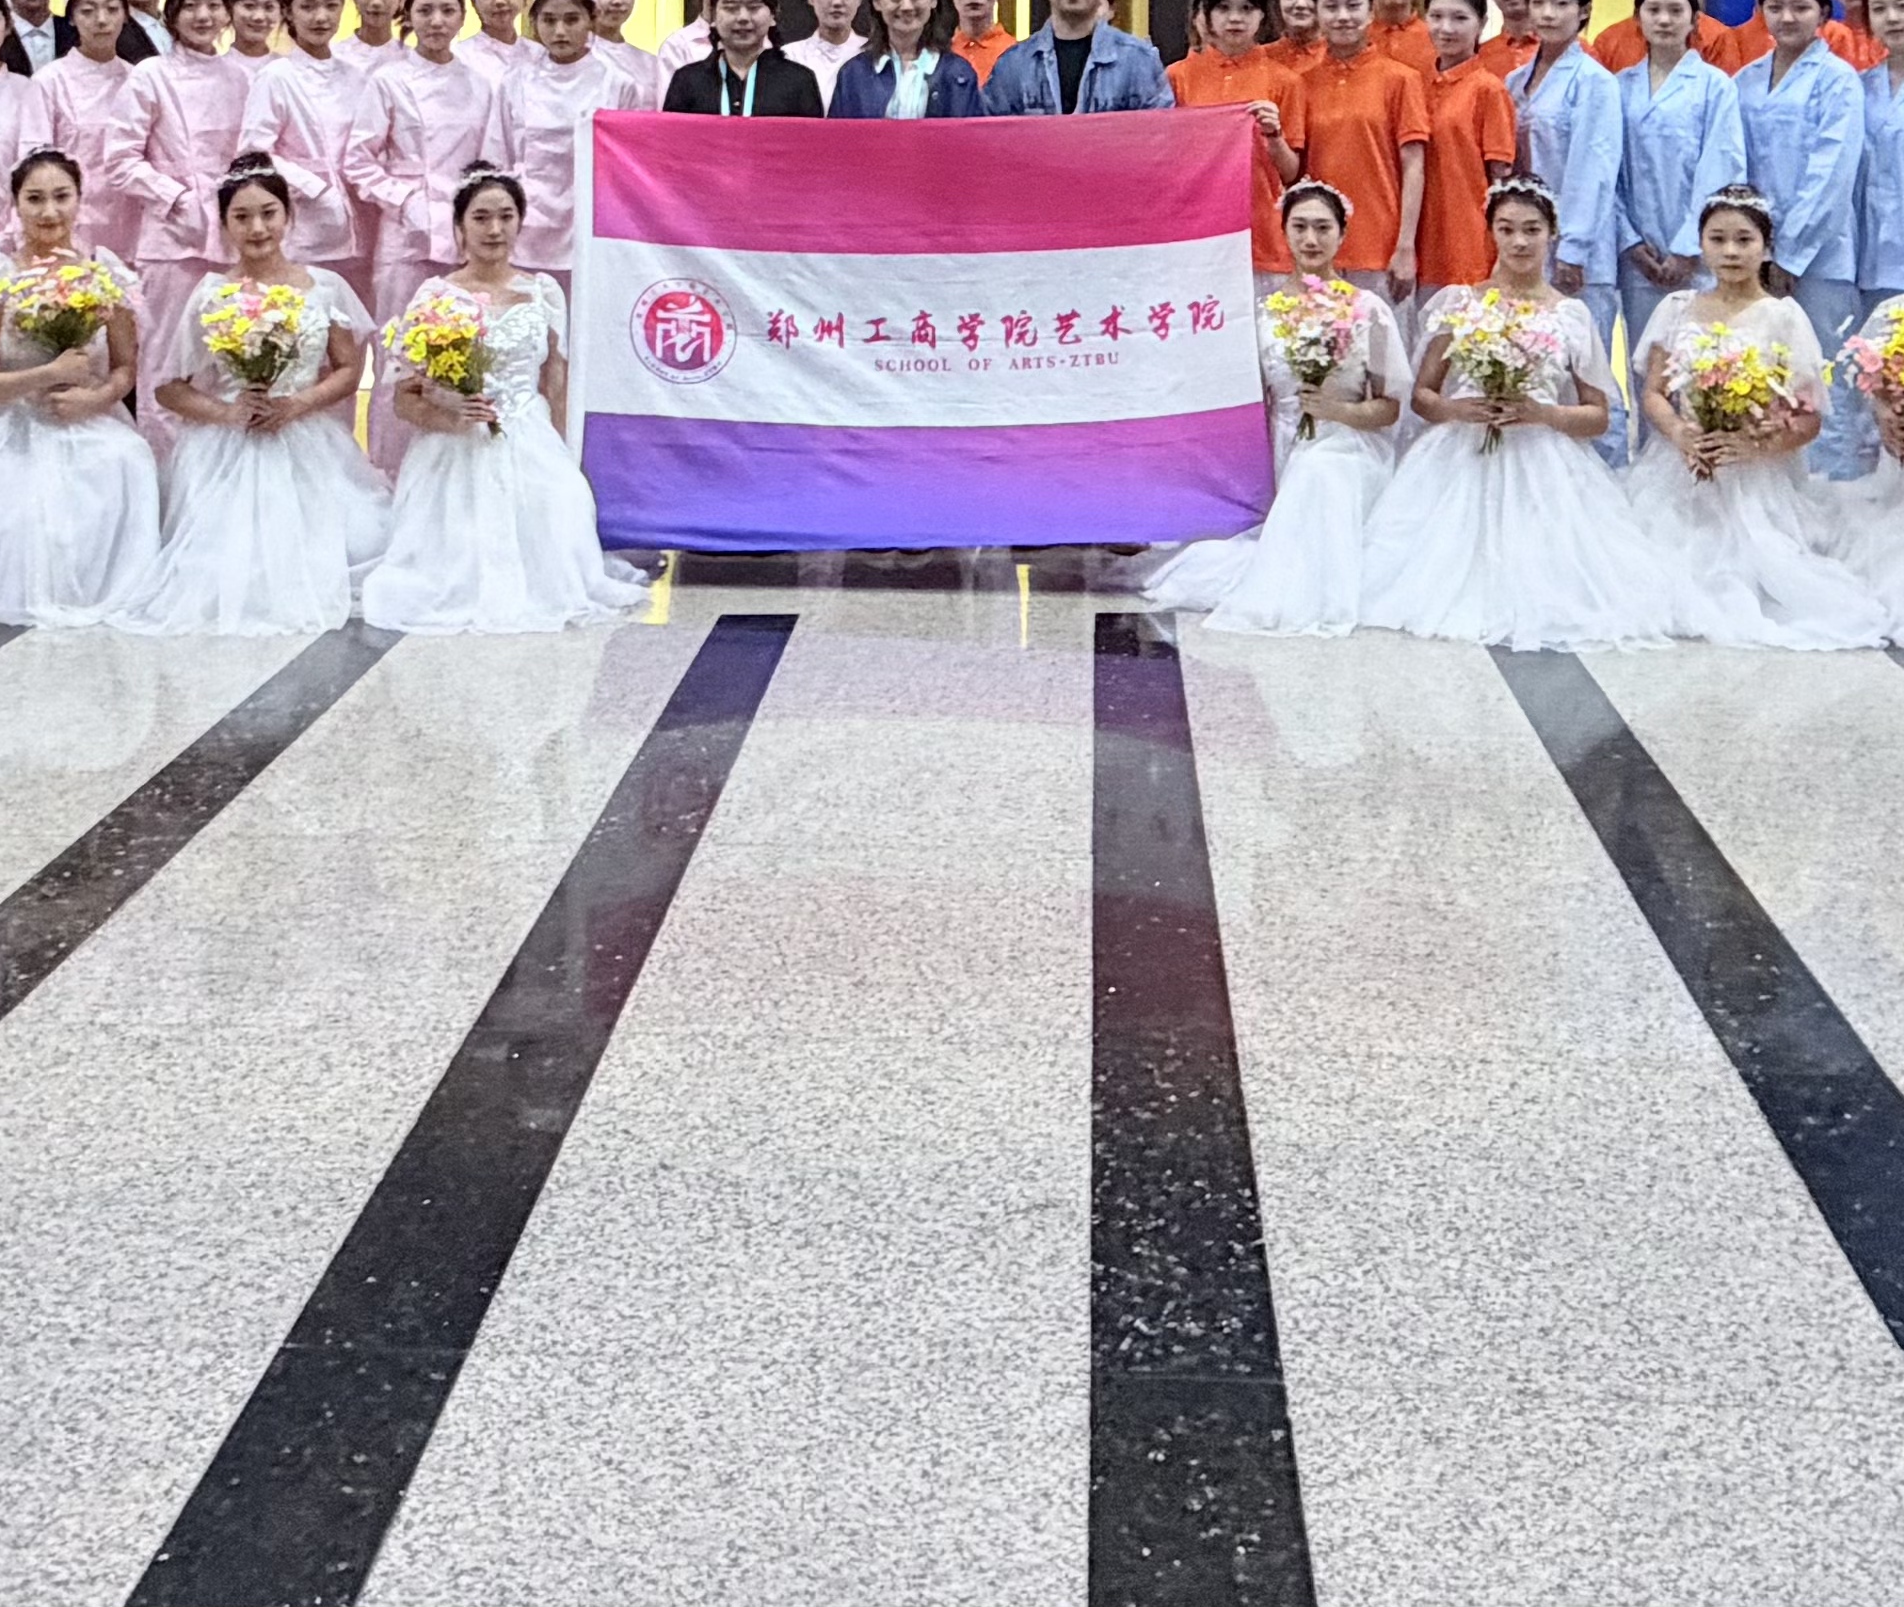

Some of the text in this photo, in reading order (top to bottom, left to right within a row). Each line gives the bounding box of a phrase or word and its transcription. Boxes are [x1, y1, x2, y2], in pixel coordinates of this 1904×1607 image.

[766, 295, 1226, 351] 郑州工商学院艺术学院
[874, 357, 953, 373] SCHOOL
[968, 357, 993, 372] OF
